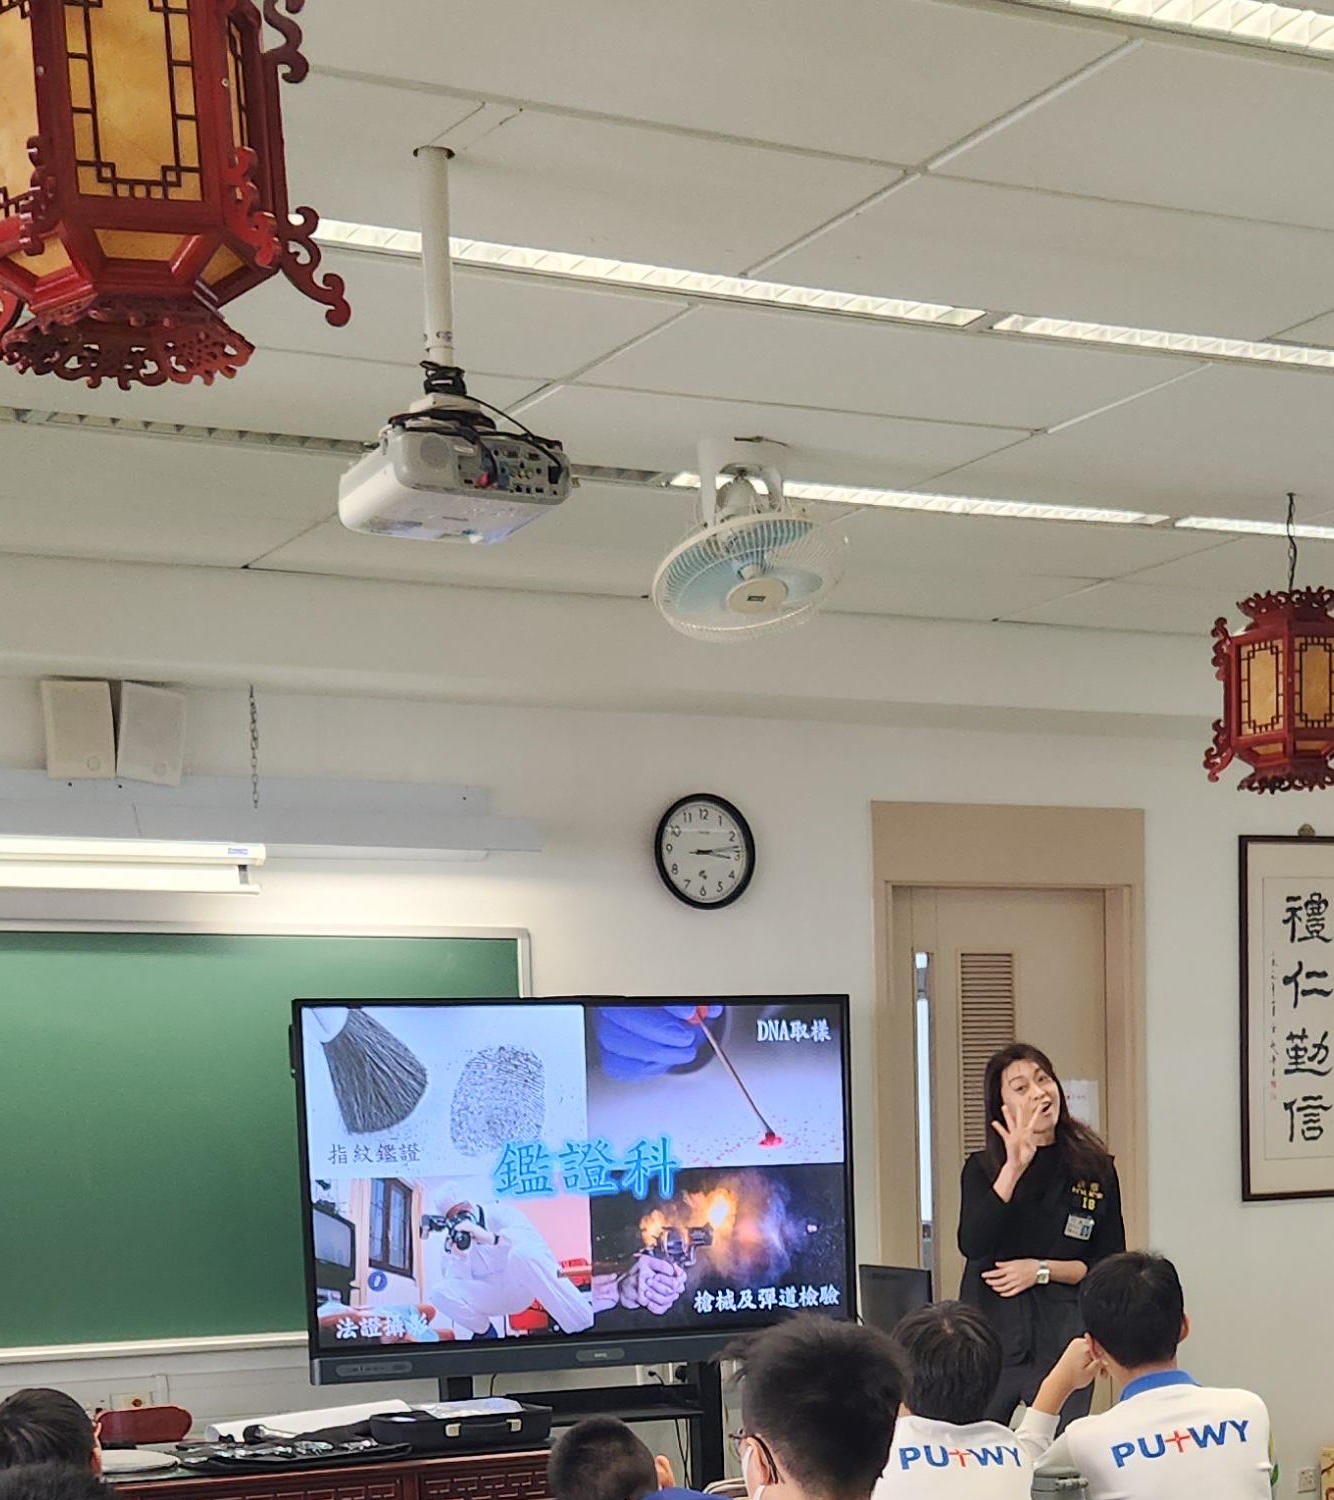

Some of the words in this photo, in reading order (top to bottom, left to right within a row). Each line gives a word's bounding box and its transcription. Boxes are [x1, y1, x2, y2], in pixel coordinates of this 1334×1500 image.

[683, 811, 692, 823] 11
[699, 808, 709, 820] 12
[718, 815, 723, 827] 1
[729, 831, 736, 842] 2
[666, 843, 673, 855] 9
[671, 863, 679, 875] 8
[728, 870, 735, 880] 4
[684, 879, 691, 889] 7
[716, 881, 724, 892] 5
[699, 886, 706, 897] 6
[1282, 892, 1334, 1143] 禮仁勤信
[756, 1018, 832, 1043] DNA取樣
[327, 1143, 422, 1166] 指紋鑑證
[493, 1136, 678, 1199] 鑑證科
[693, 1284, 841, 1314] 槍械及彈道檢驗
